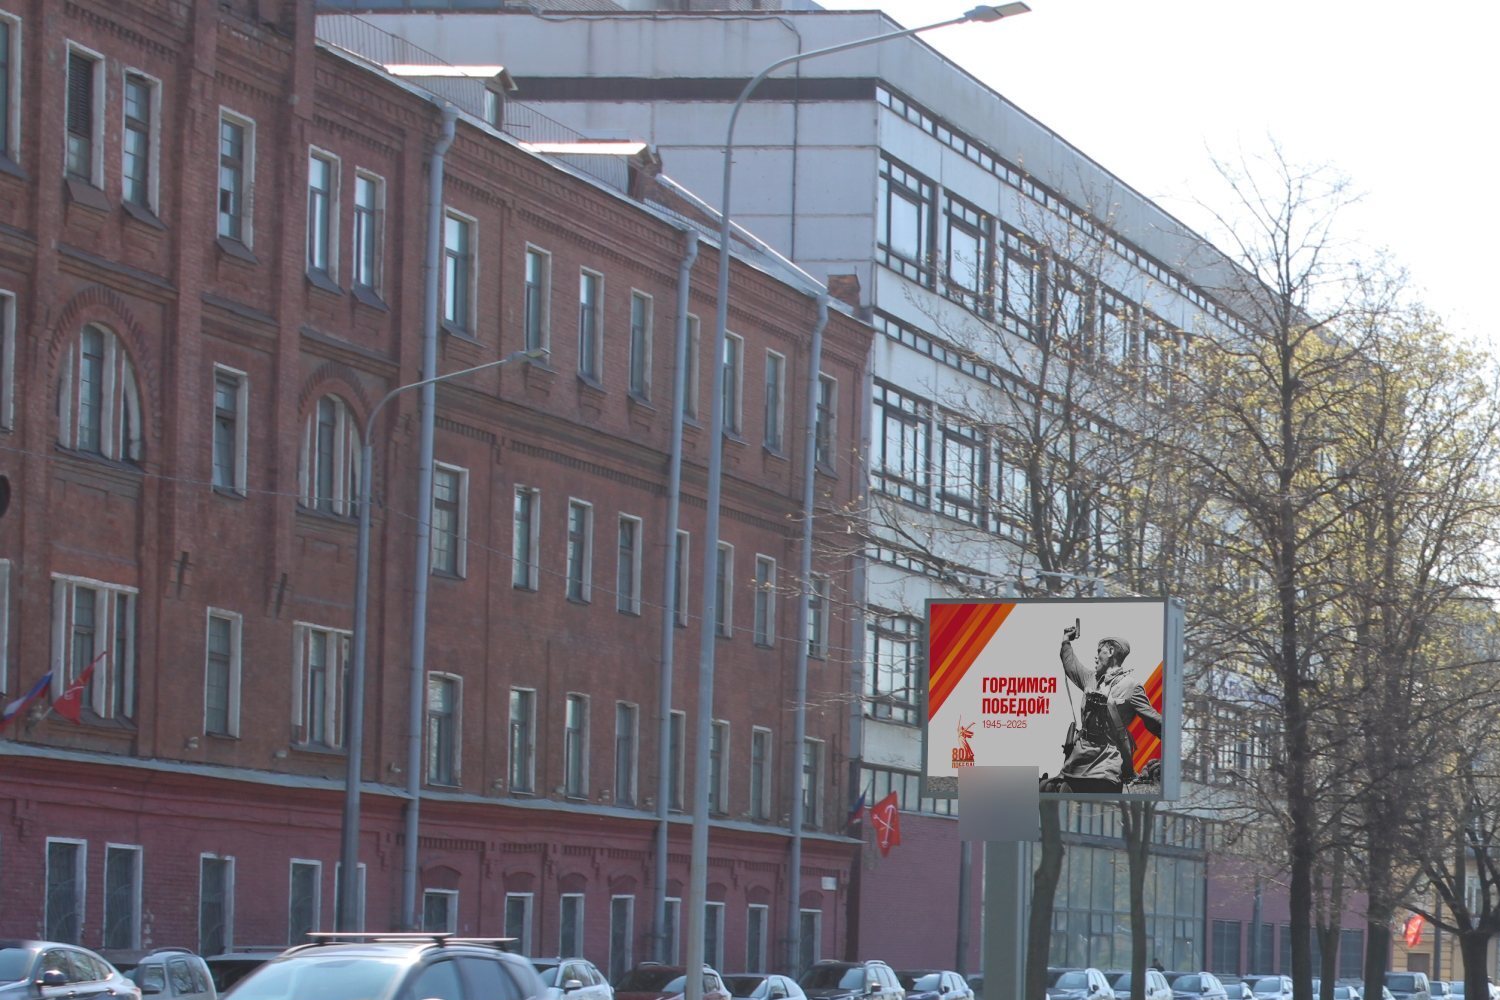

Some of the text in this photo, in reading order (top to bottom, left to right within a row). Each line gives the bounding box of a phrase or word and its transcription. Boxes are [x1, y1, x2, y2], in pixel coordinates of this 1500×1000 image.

[982, 677, 1057, 696] ГОРДИМСЯ
[982, 696, 1050, 717] ПОБЕДОЙ!
[952, 748, 965, 761] 80
